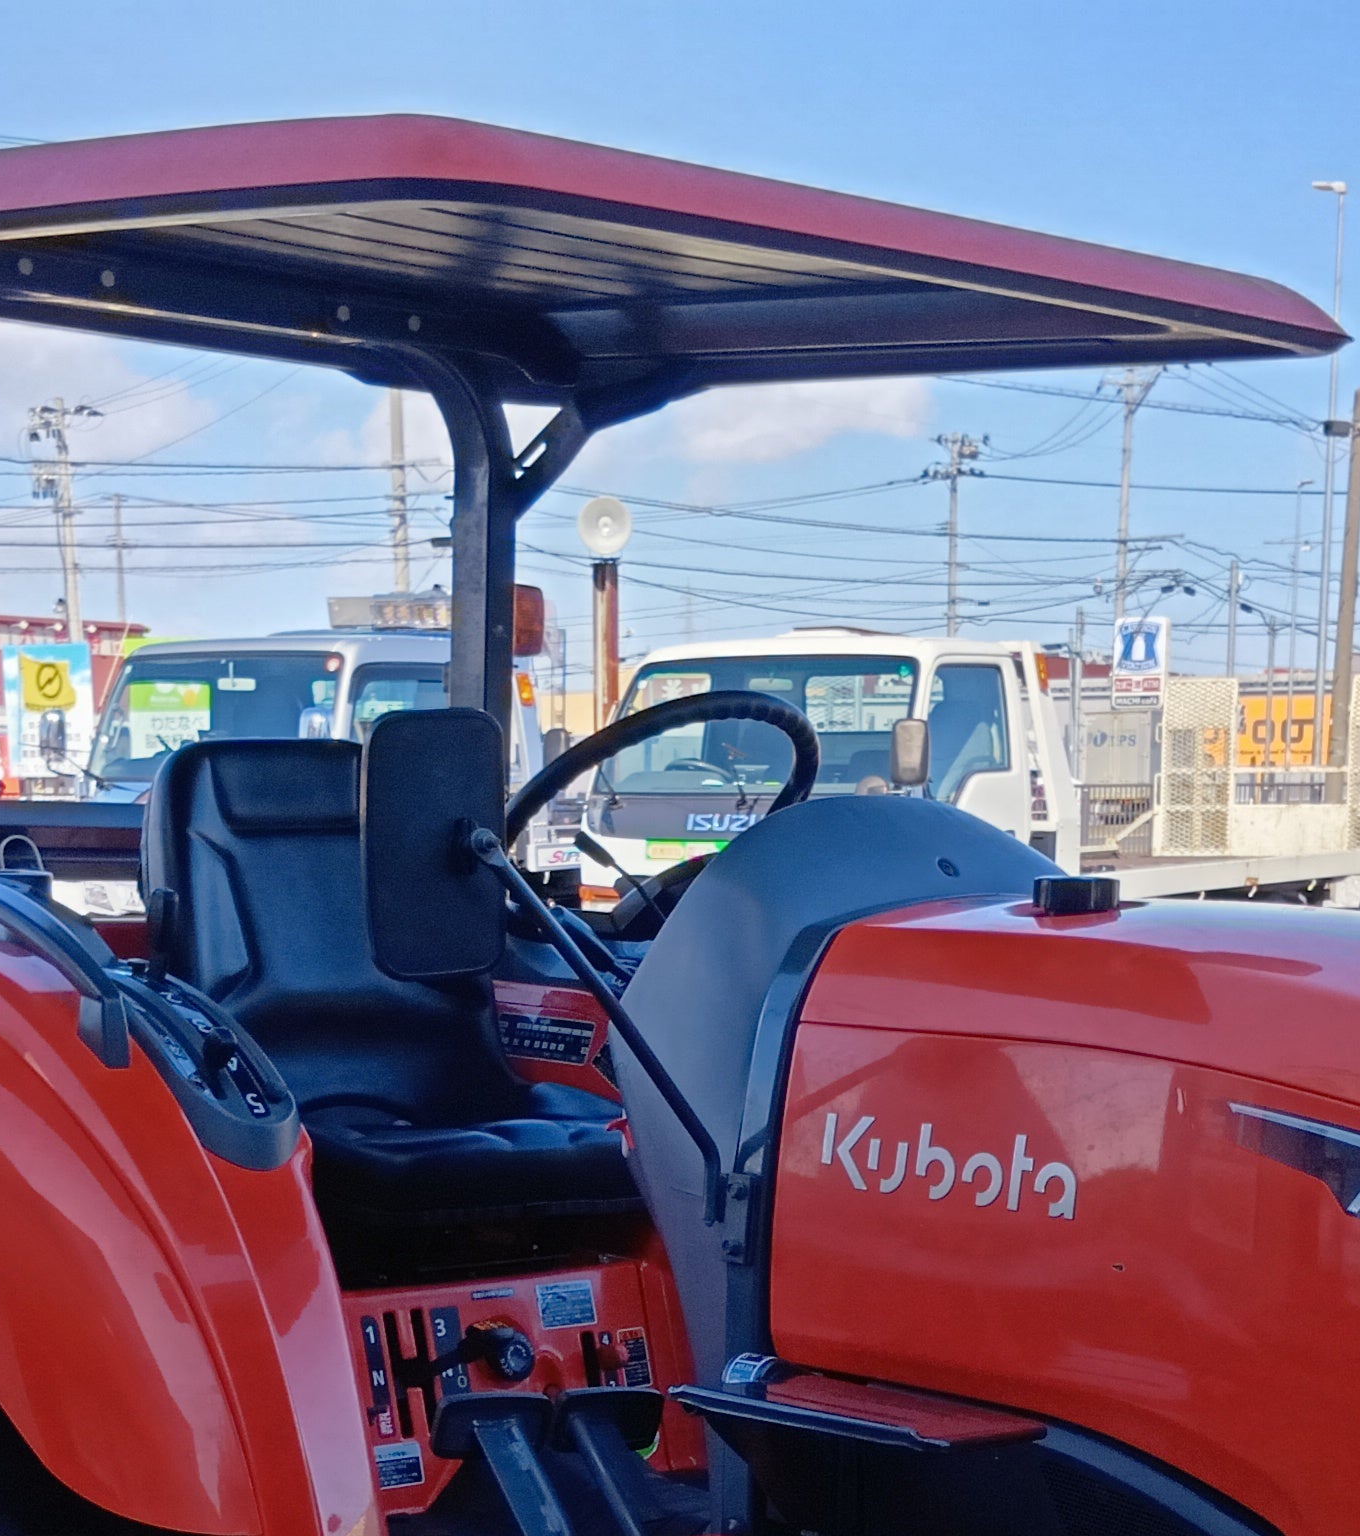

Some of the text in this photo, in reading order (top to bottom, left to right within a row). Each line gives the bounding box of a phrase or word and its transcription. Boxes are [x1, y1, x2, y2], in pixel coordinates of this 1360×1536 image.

[821, 1113, 1078, 1220] Kubota
[365, 1325, 376, 1344] 1
[434, 1318, 447, 1337] 3
[372, 1369, 386, 1387] N
